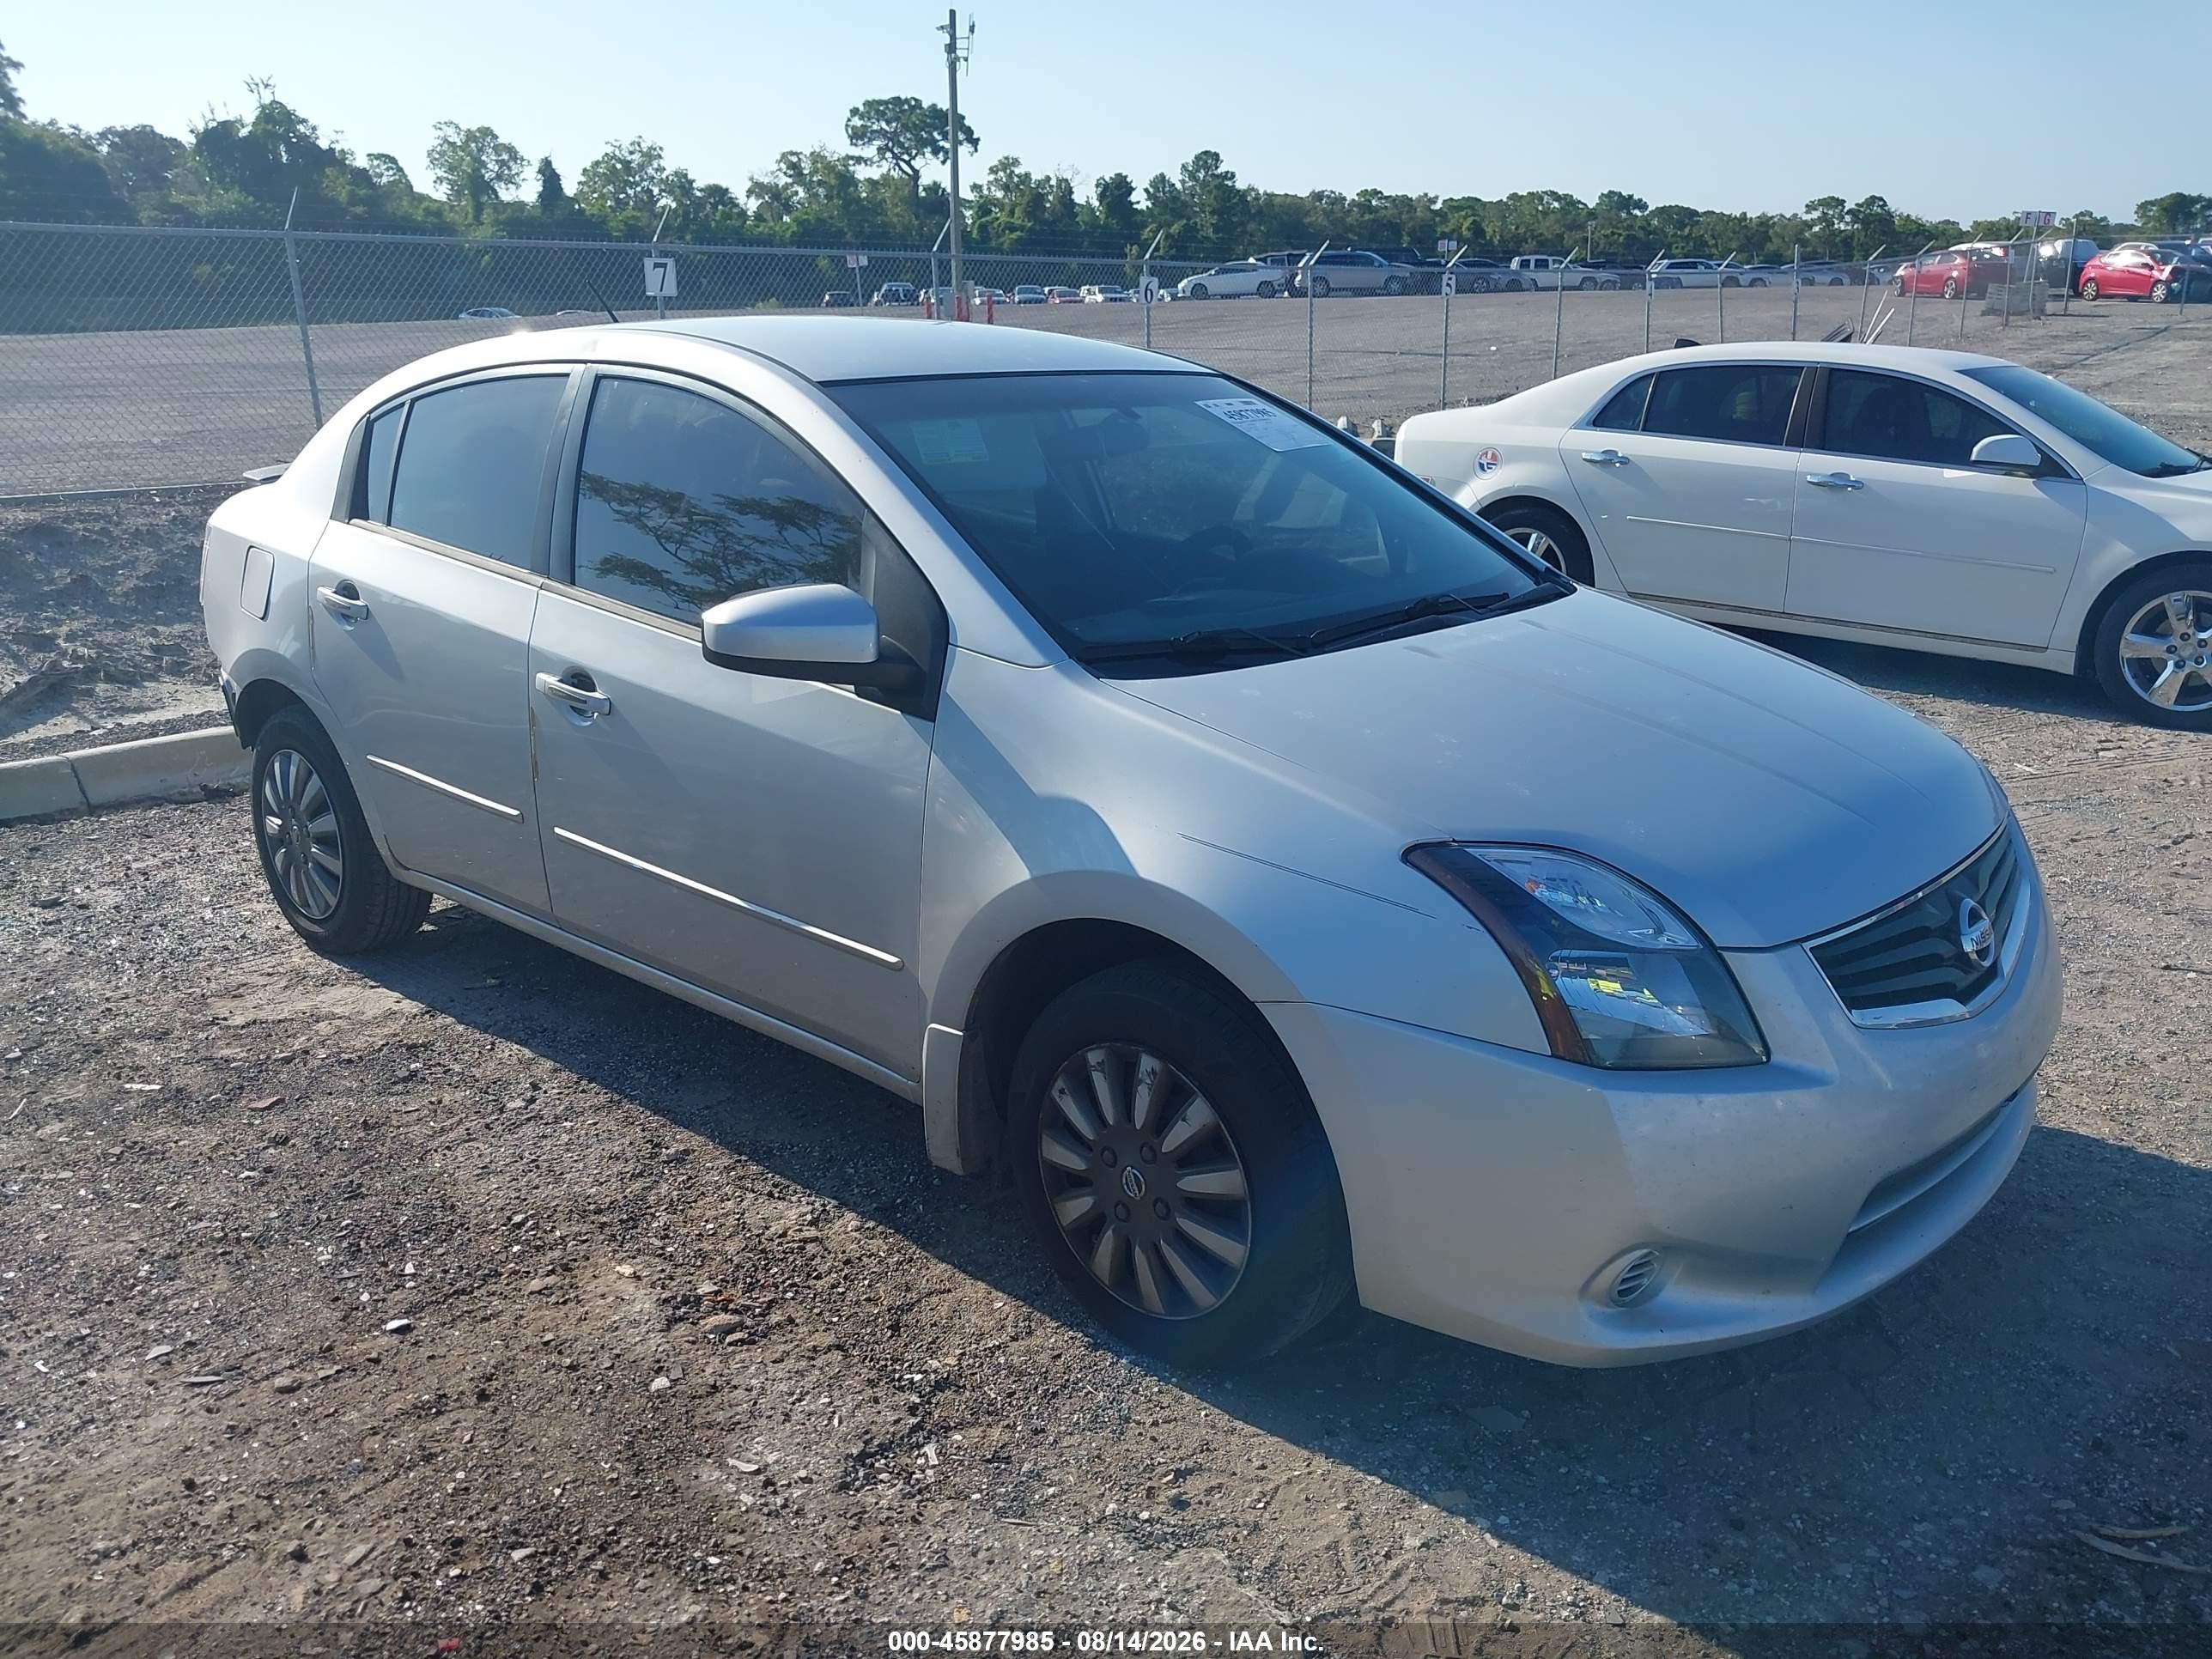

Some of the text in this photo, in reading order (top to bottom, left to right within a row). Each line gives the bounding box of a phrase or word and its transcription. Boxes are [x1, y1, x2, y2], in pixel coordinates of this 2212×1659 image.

[2025, 212, 2032, 224] F
[2044, 213, 2051, 225] G
[653, 262, 668, 293] 7
[1445, 276, 1453, 295] 5
[1145, 280, 1154, 304] 6
